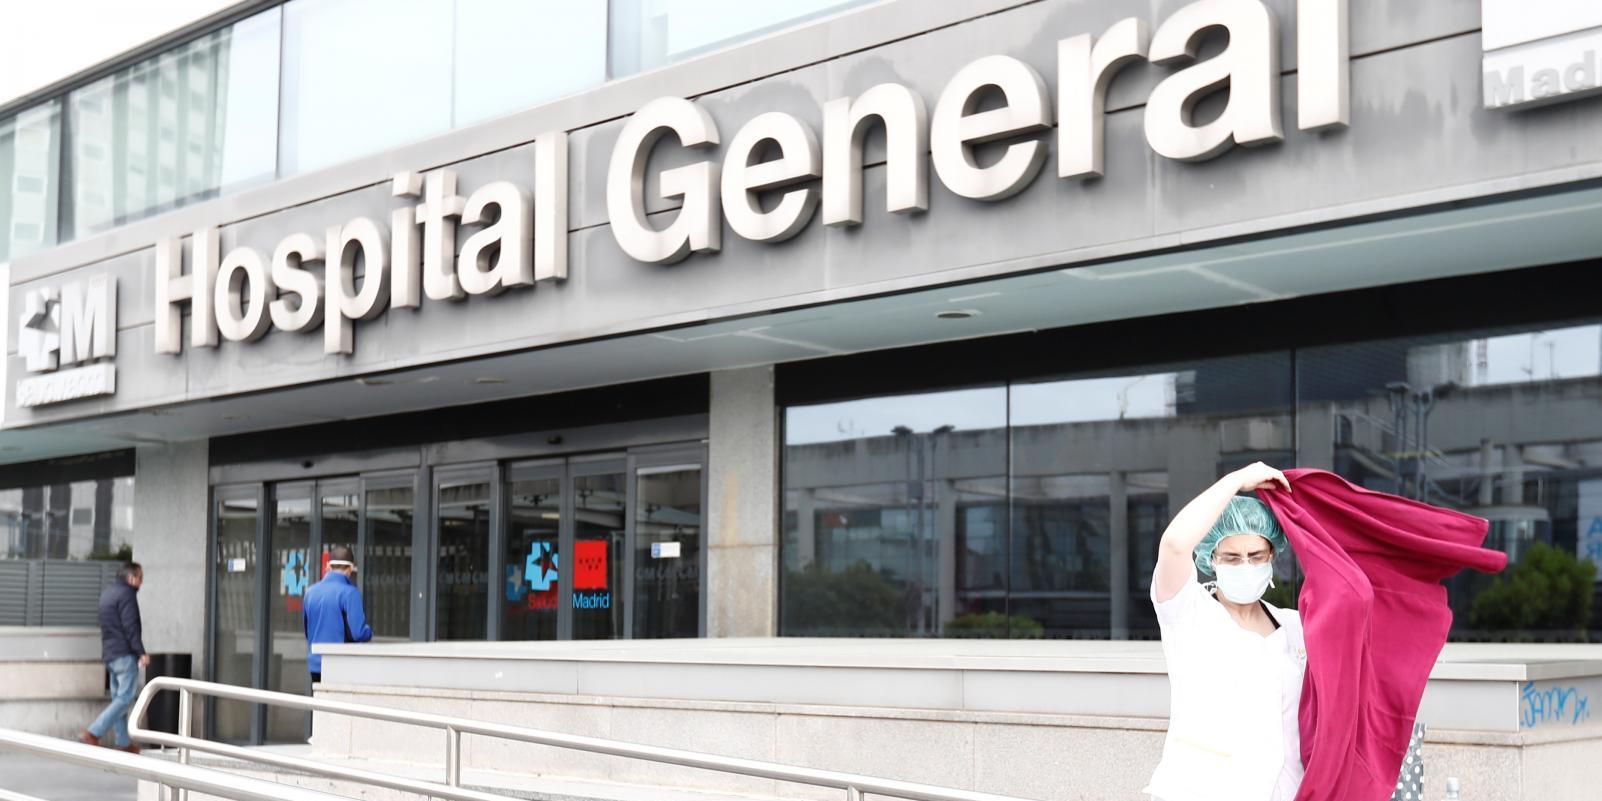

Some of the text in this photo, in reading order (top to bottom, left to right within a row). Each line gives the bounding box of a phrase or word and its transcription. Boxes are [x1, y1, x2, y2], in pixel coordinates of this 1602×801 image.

[1483, 50, 1602, 107] Mad
[154, 0, 1349, 355] Hospital General
[572, 592, 609, 608] Madrid
